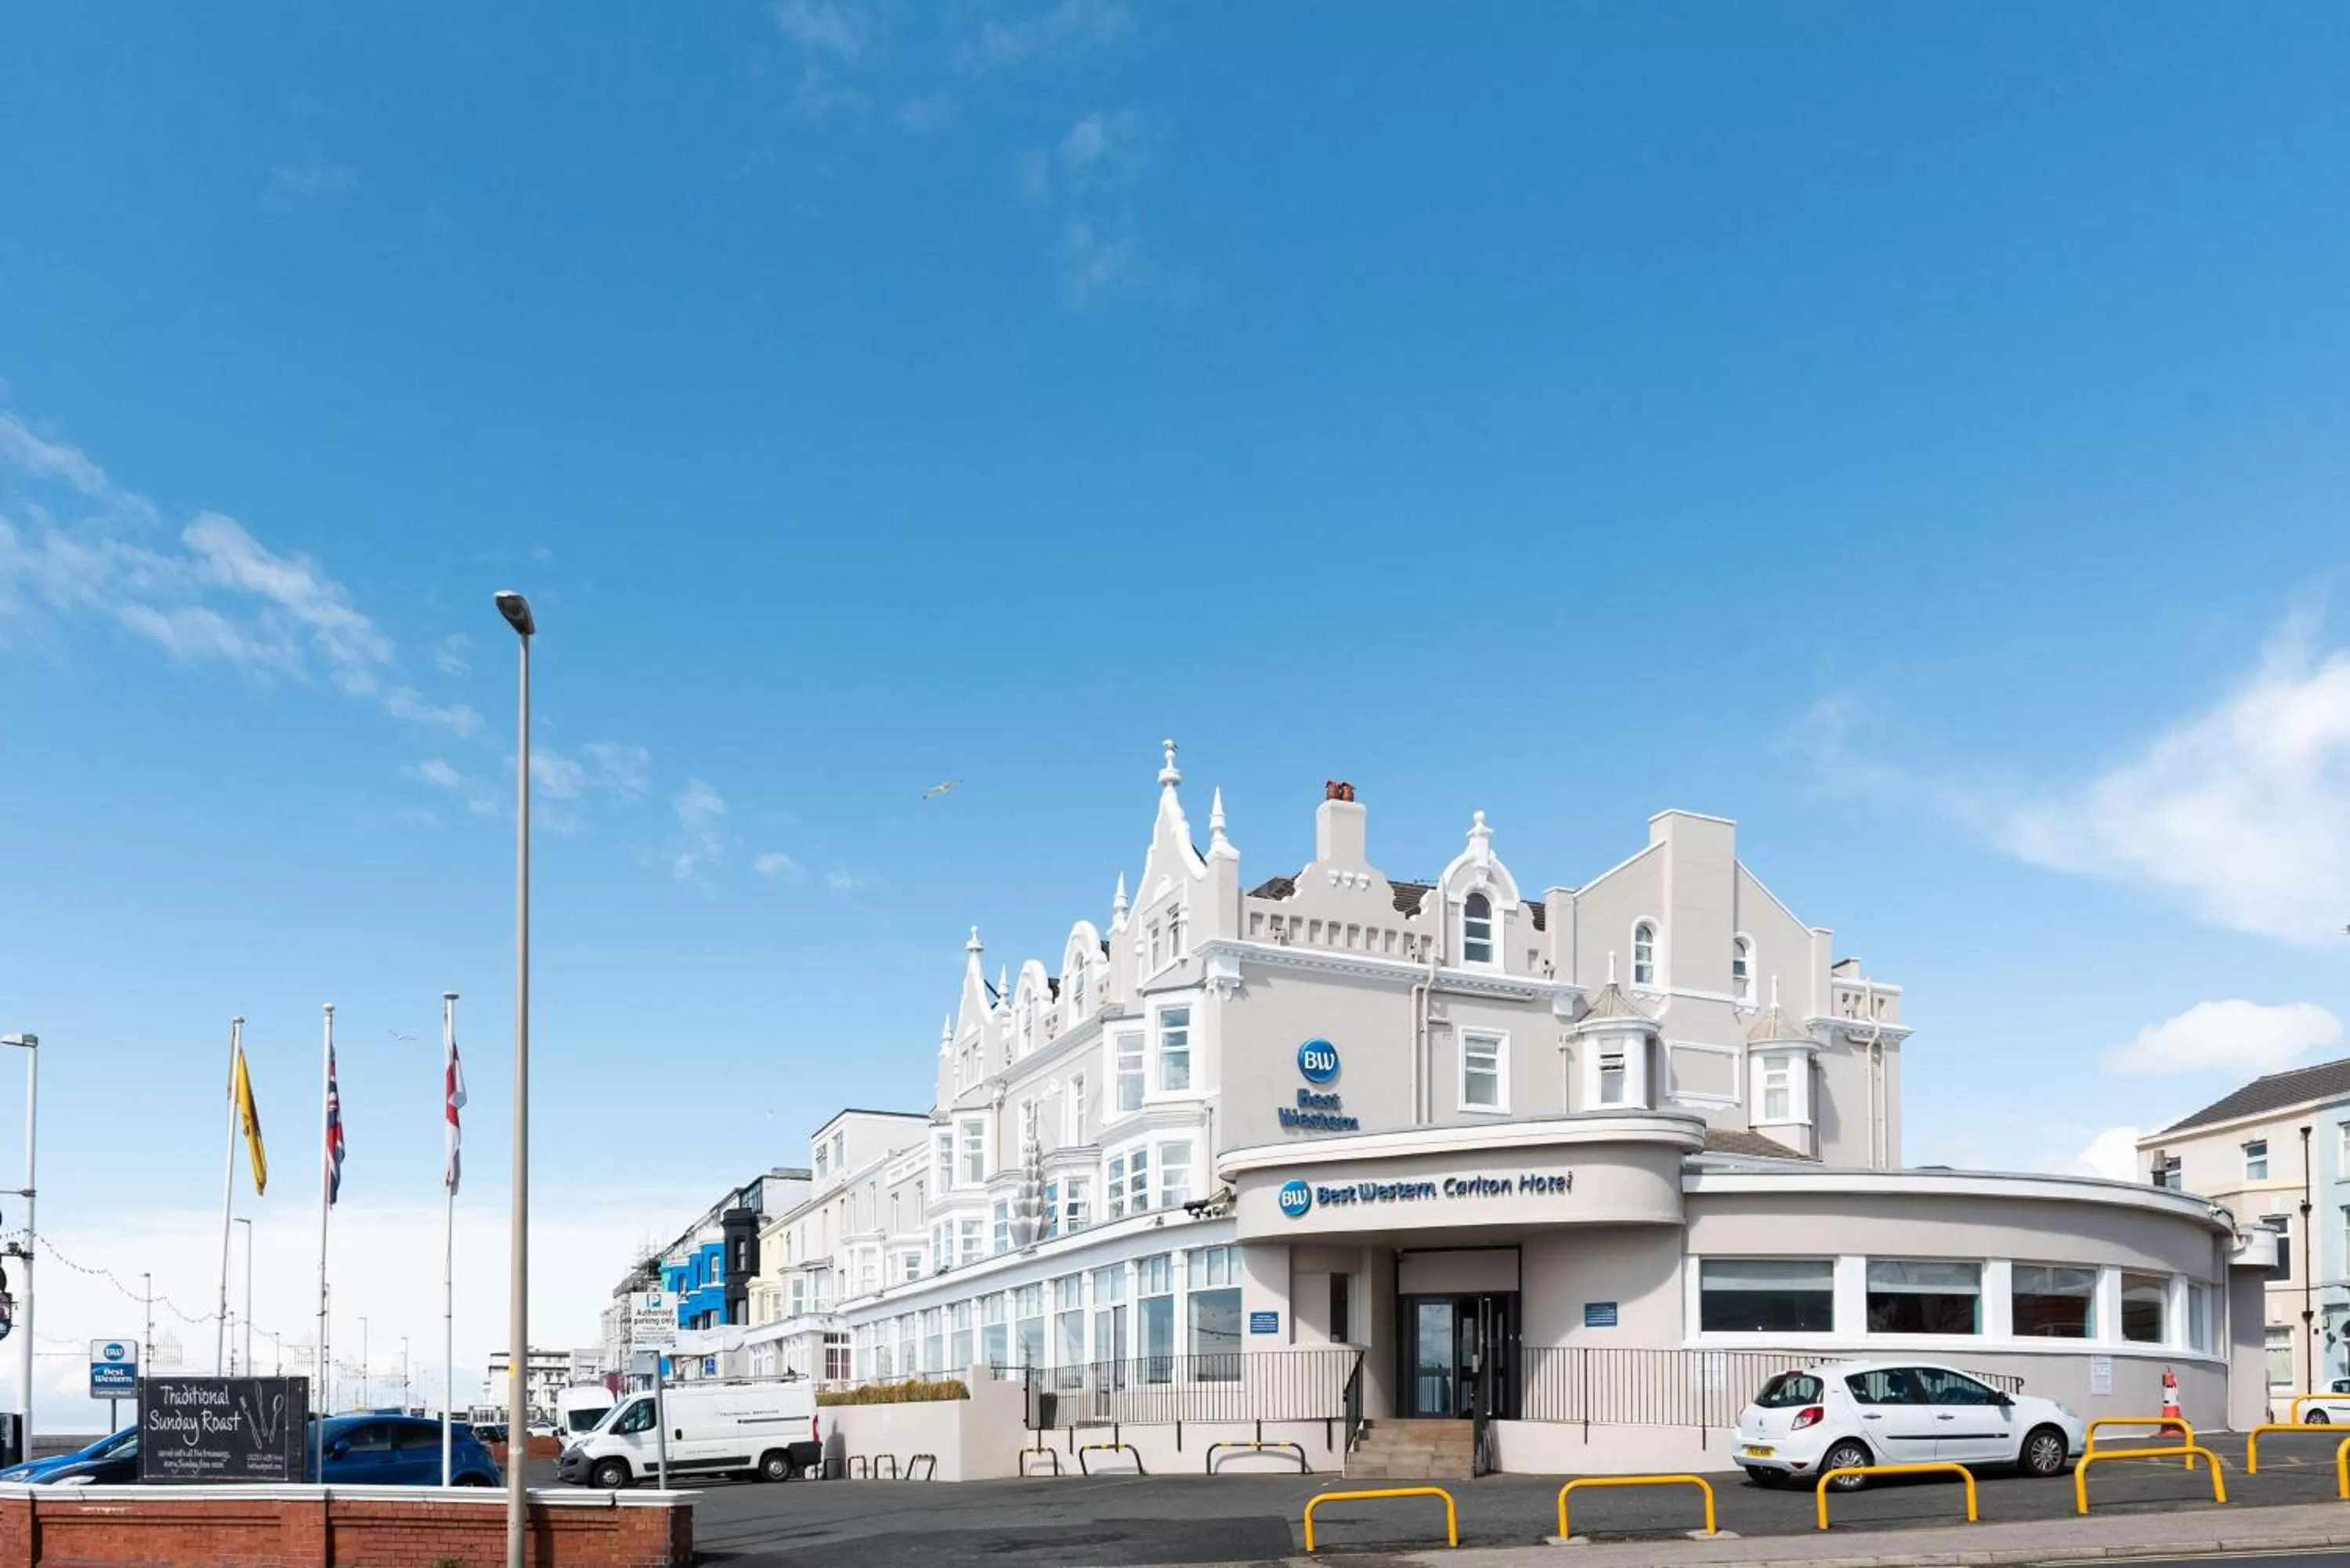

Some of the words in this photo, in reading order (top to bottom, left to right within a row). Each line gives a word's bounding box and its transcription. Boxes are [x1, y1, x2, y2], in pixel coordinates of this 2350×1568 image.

[1304, 1050, 1336, 1071] BW
[1297, 1088, 1342, 1111] Best
[1278, 1107, 1360, 1132] Western
[1282, 1189, 1307, 1207] BW
[1317, 1186, 1357, 1205] Best
[1358, 1181, 1437, 1203] Western
[1443, 1176, 1513, 1199] Carlton
[1518, 1172, 1574, 1197] Hotel
[95, 1375, 132, 1383] Western
[103, 1367, 124, 1376] Best
[159, 1384, 230, 1405] Traditional
[148, 1409, 200, 1447] Sunday
[201, 1409, 242, 1434] Roast
